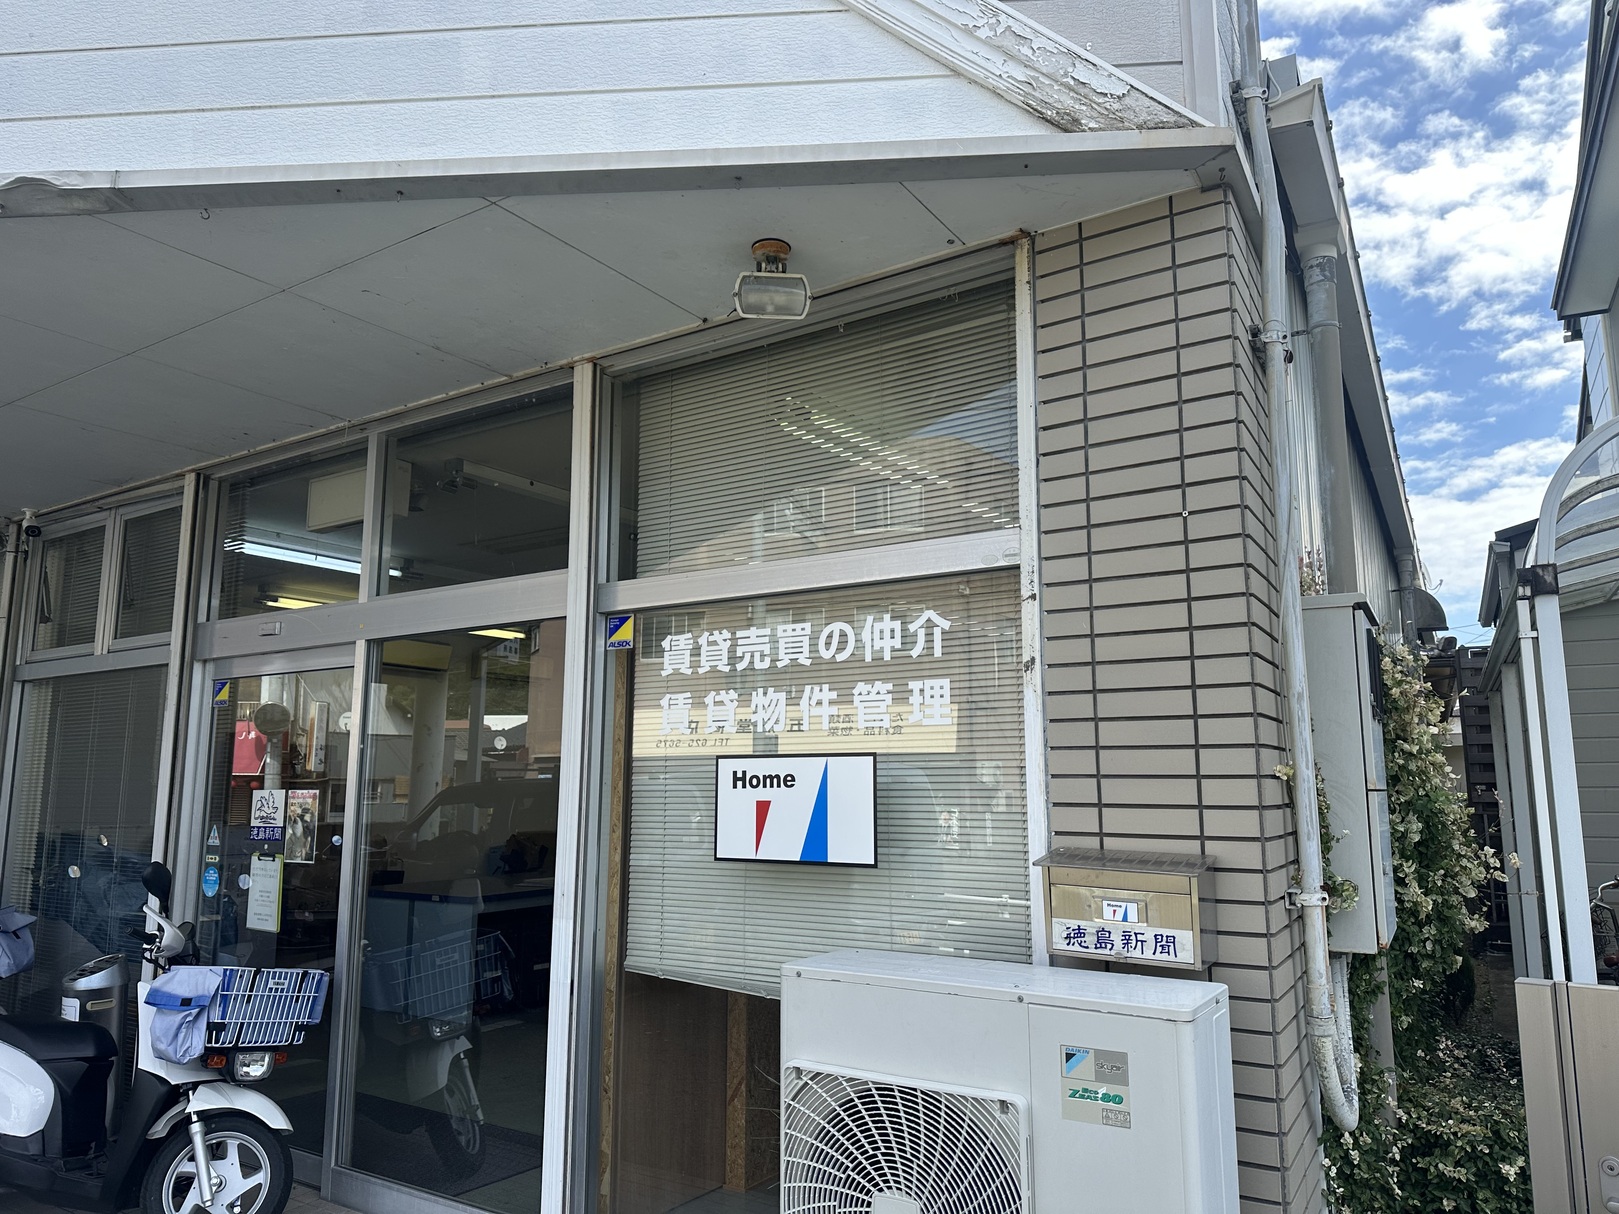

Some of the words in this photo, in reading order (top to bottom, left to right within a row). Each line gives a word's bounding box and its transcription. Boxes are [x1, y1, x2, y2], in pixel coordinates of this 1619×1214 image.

[607, 640, 631, 648] ALSOK
[661, 609, 952, 677] 賃貸売買の仲介
[659, 678, 953, 736] 賃貸物件管理
[732, 770, 796, 790] Home
[1065, 924, 1178, 958] 徳島新聞
[1065, 1047, 1090, 1055] DAIKIN
